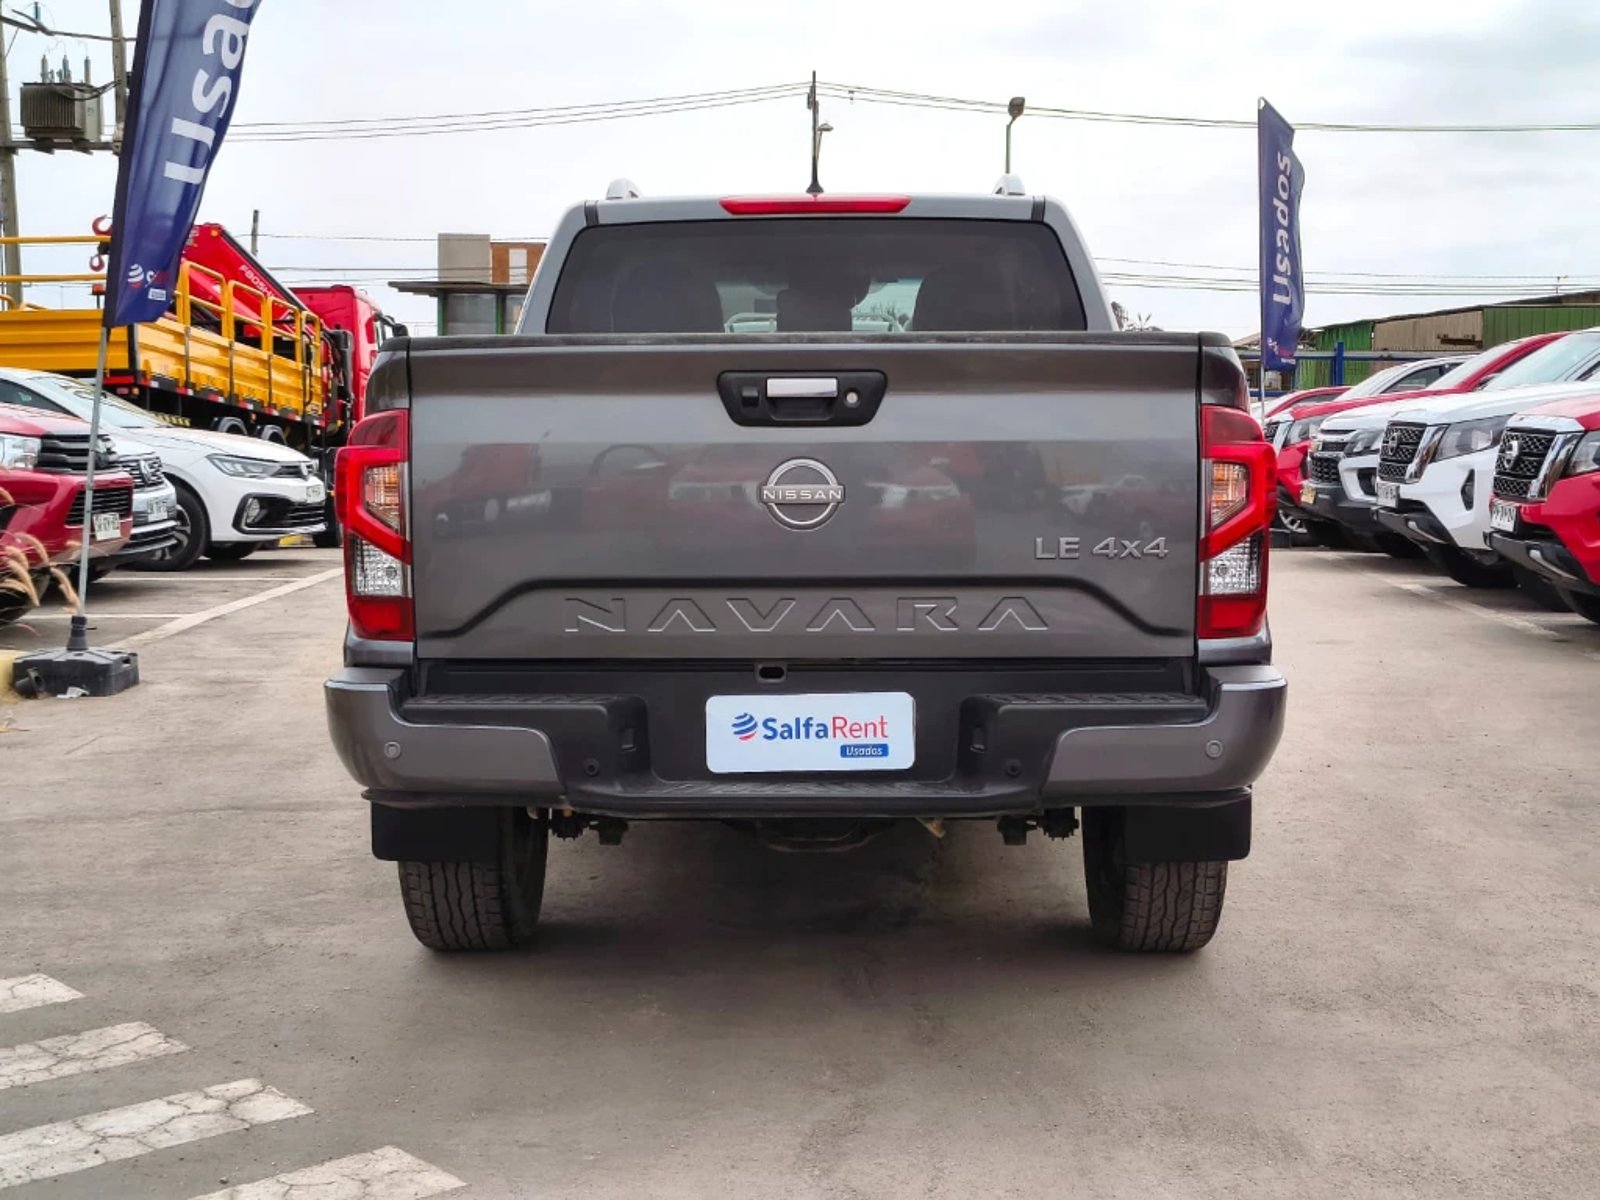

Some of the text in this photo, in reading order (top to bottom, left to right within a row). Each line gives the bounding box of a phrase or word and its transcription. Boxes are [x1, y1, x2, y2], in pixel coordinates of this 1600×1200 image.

[164, 0, 254, 185] Usa
[1273, 152, 1292, 306] Usados
[763, 490, 842, 500] NISSAN
[1035, 536, 1169, 559] LE 4x4
[564, 597, 1049, 633] NAVARA
[762, 715, 889, 741] SalfaRent
[846, 746, 883, 756] Usados
